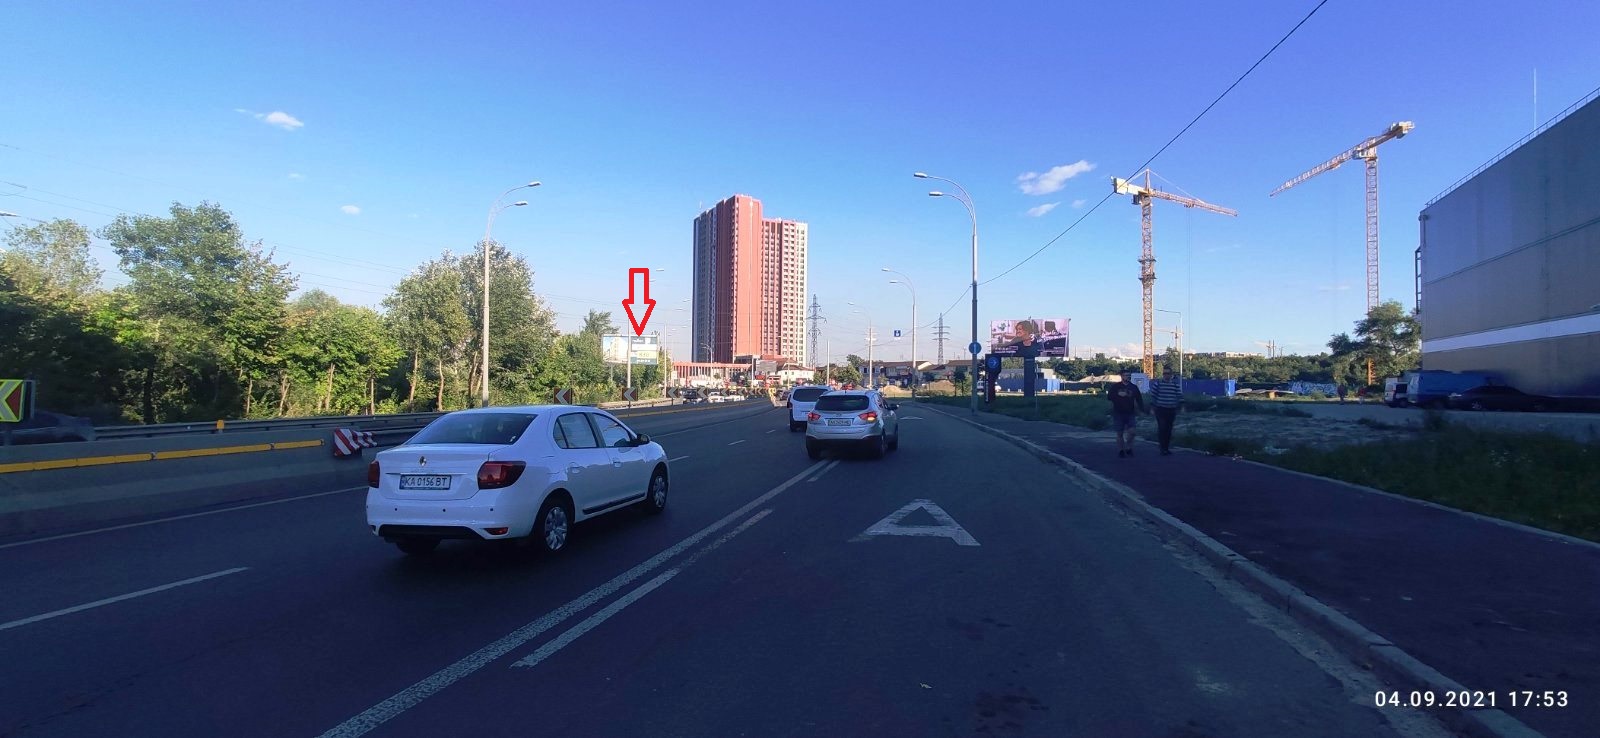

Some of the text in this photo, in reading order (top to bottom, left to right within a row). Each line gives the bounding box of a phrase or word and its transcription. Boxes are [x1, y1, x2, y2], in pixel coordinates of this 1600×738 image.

[404, 477, 448, 487] KA 0156 BT
[848, 498, 981, 546] A
